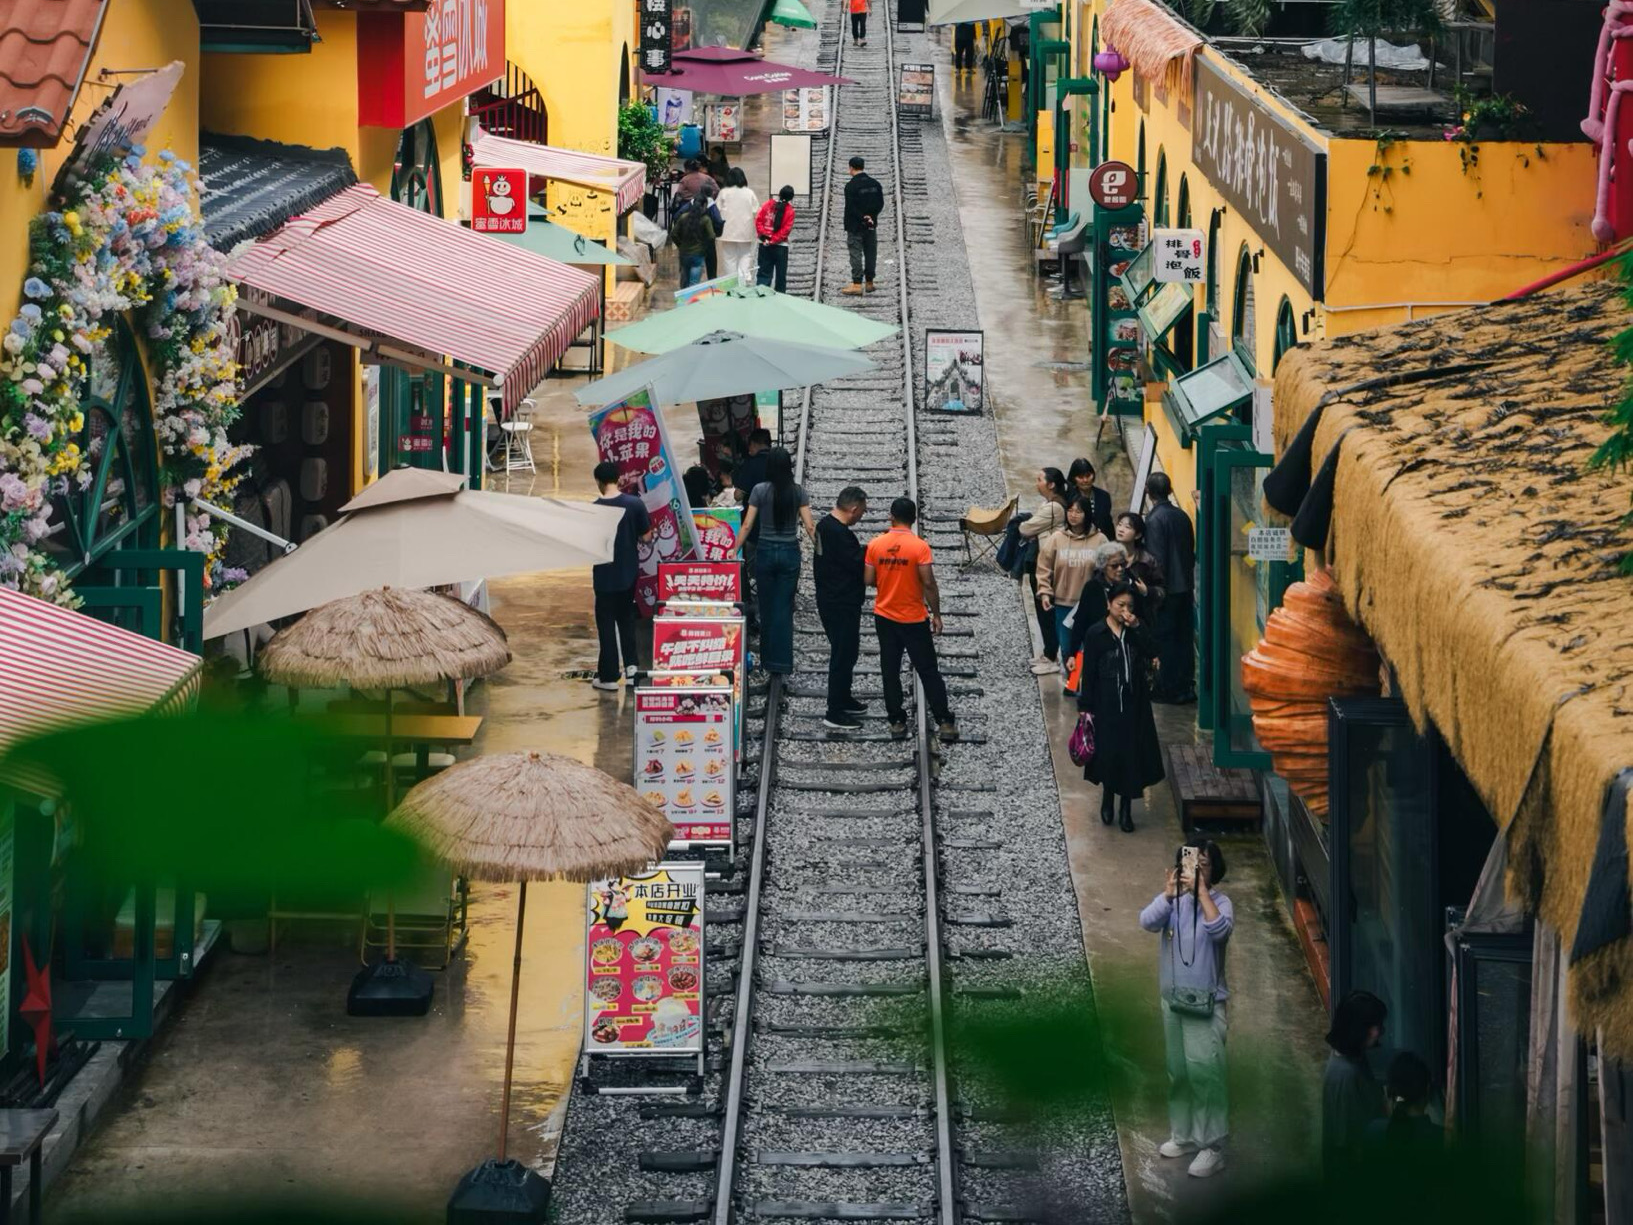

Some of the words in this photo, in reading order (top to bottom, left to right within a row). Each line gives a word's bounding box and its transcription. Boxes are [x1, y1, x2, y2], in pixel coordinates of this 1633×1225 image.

[474, 217, 523, 231] 蜜雪冰城
[600, 420, 656, 452] 你是我的
[604, 442, 649, 463] 小苹果
[635, 883, 697, 898] 本店开业
